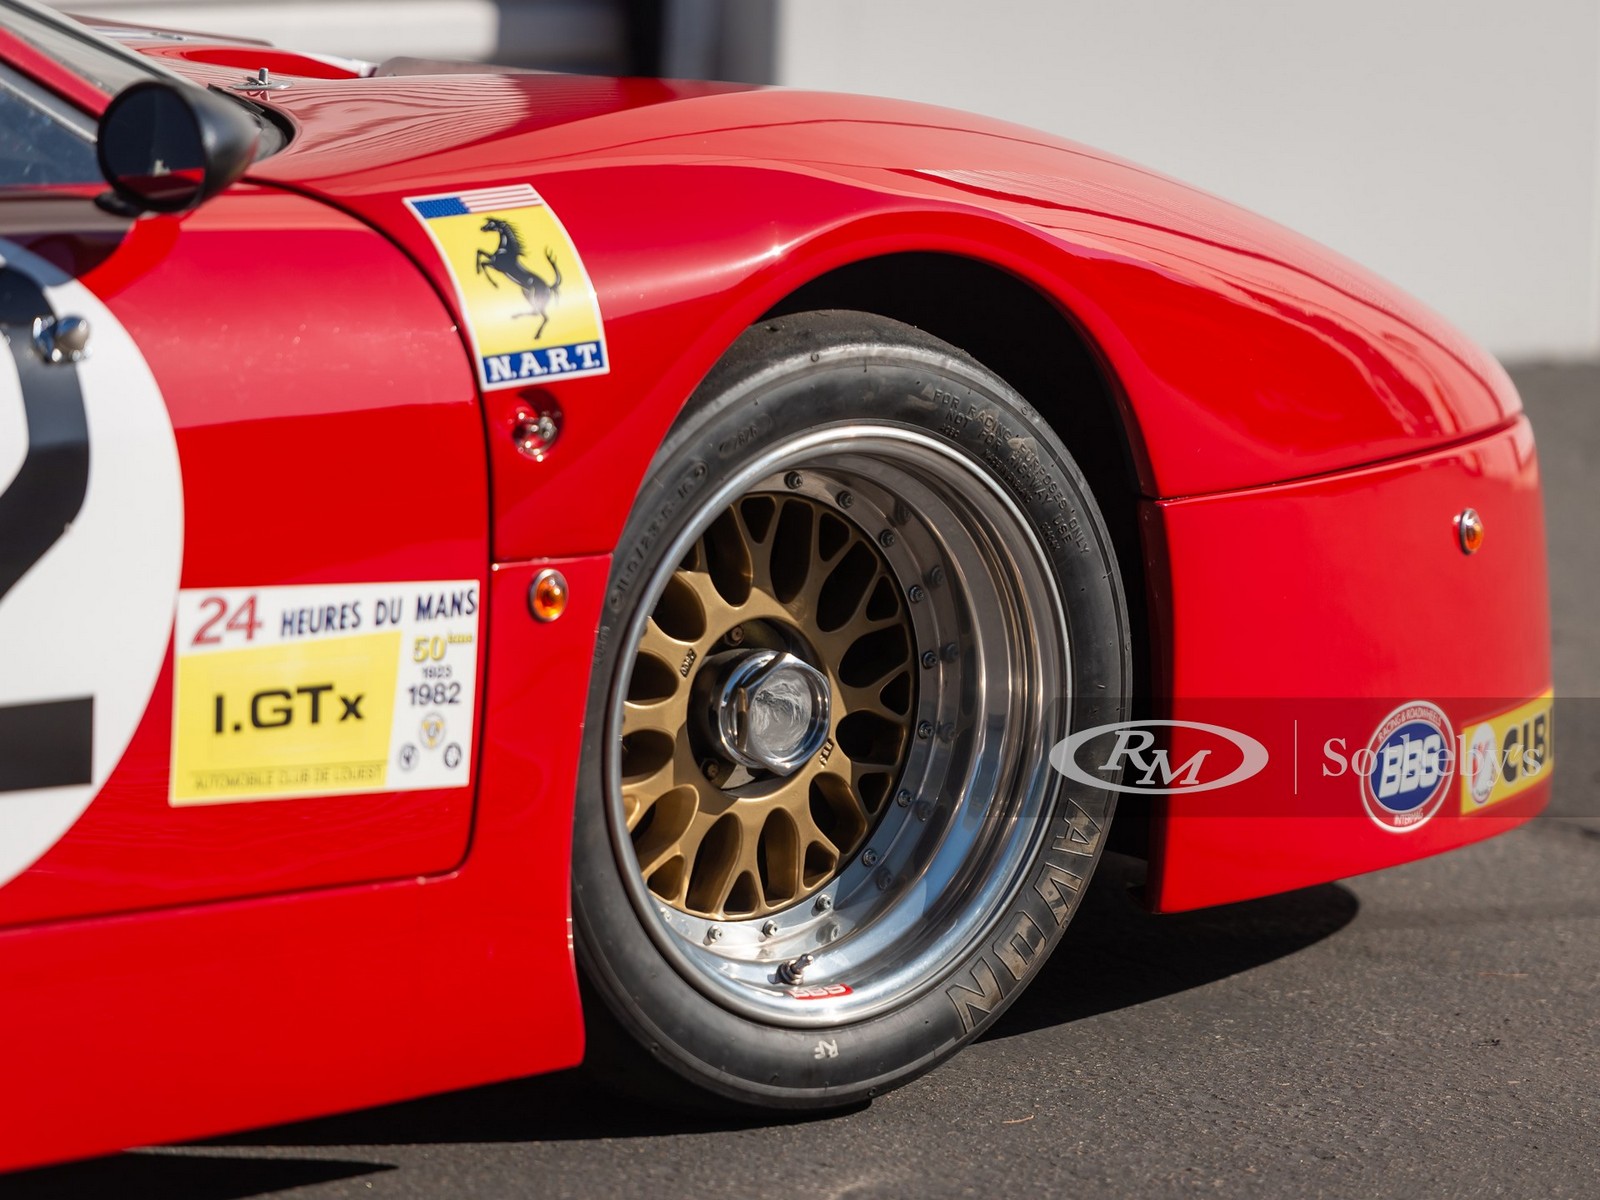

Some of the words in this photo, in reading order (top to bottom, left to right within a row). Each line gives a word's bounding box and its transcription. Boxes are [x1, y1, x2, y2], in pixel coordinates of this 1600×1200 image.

[487, 343, 600, 381] N.A.R.T.
[934, 389, 960, 409] FOR
[967, 404, 1012, 441] RACING
[1019, 444, 1068, 511] PURPOSES
[1069, 517, 1090, 555] ONLY
[946, 410, 973, 428] NOT
[978, 430, 1003, 451] FOR
[1008, 450, 1053, 506] HIGHWAY
[1053, 513, 1073, 544] USE
[191, 593, 262, 646] 24
[280, 601, 361, 638] HEURES
[375, 598, 402, 626] DU
[415, 589, 477, 621] MANS
[408, 682, 462, 706] 1982
[1378, 734, 1440, 799] BBS
[946, 798, 1101, 1034] AVON
[814, 1039, 839, 1060] RF
